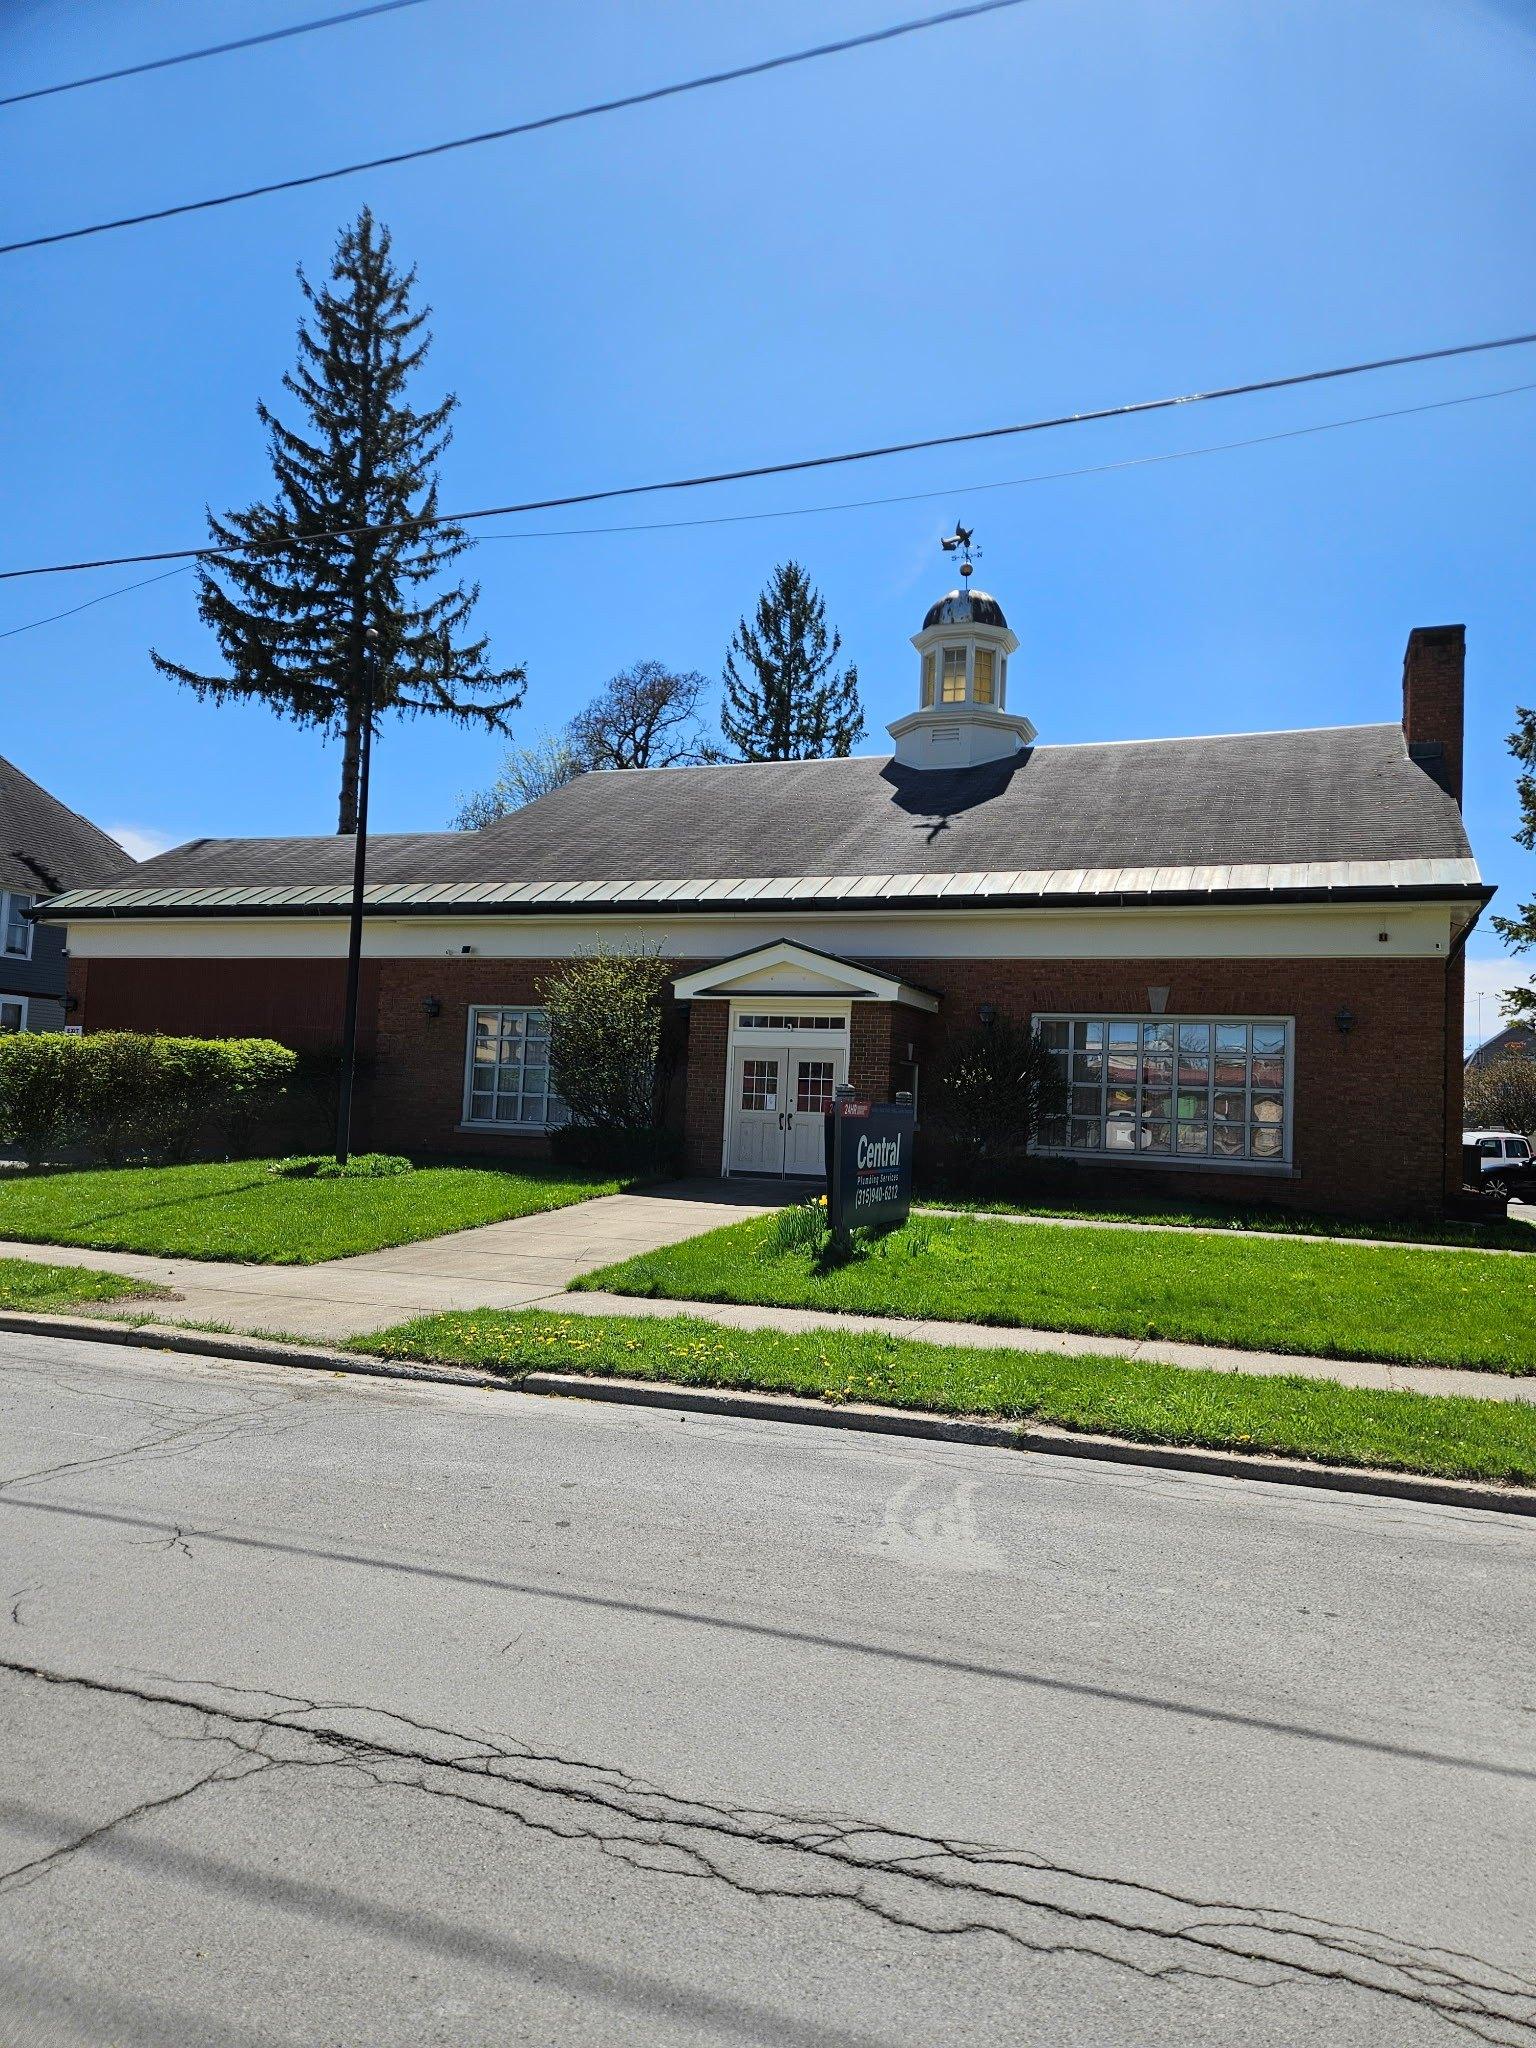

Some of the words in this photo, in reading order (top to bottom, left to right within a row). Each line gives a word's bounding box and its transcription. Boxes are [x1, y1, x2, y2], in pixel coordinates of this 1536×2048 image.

[858, 1133, 901, 1169] Central
[857, 1175, 879, 1185] Plumbing
[880, 1174, 899, 1182] Services
[856, 1185, 898, 1209] (315)940-6212
